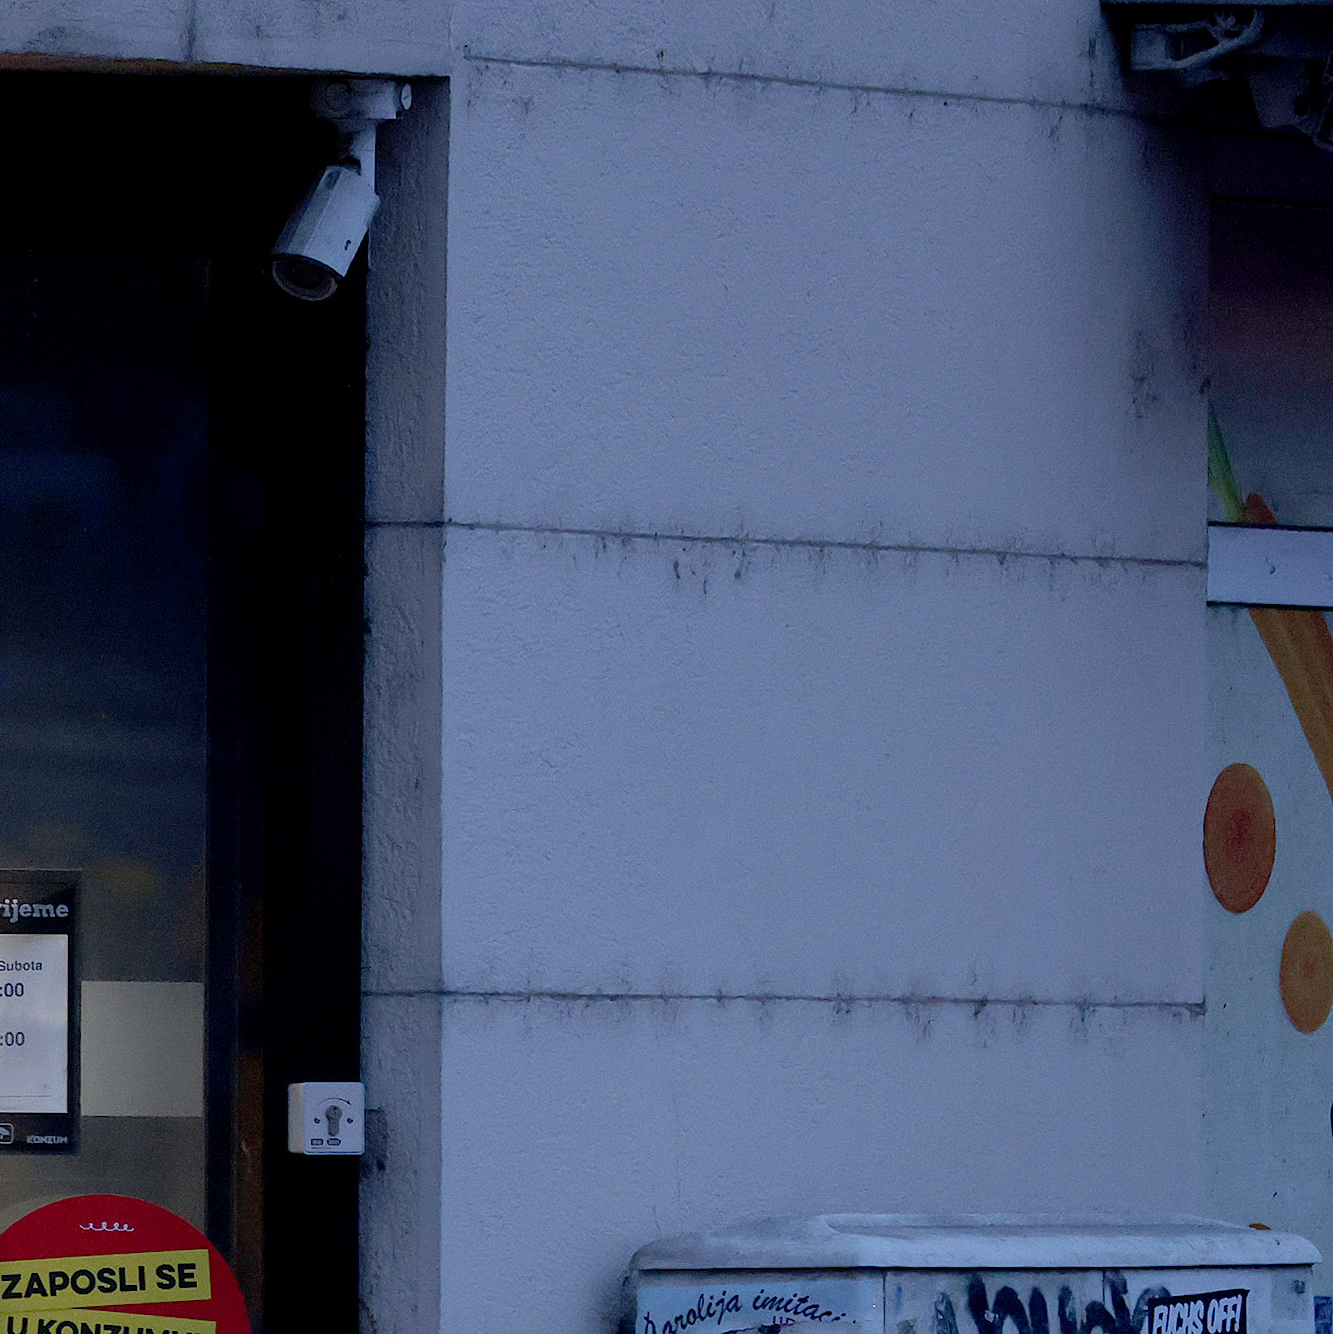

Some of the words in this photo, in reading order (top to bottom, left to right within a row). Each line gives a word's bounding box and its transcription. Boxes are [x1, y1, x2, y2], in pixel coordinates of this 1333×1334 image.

[1, 1265, 147, 1300] ZAPOSLI
[155, 1263, 198, 1289] SE
[1207, 1294, 1243, 1334] OFF!
